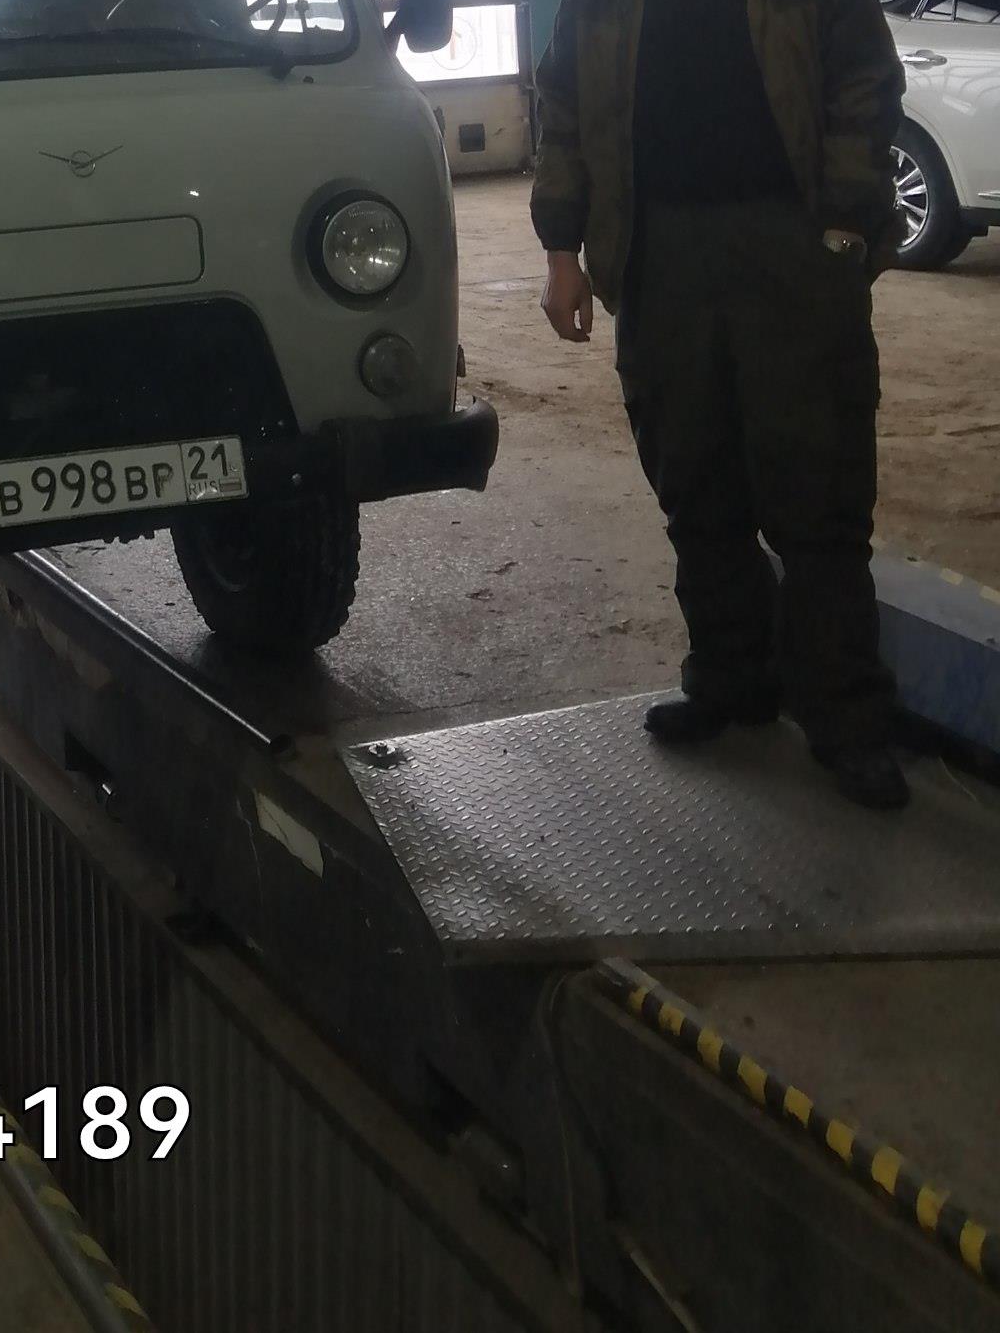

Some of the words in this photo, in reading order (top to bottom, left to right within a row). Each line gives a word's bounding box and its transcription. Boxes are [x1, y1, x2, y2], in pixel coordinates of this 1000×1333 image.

[187, 443, 229, 480] 21
[0, 460, 174, 517] В998ВР
[188, 480, 218, 496] RUS
